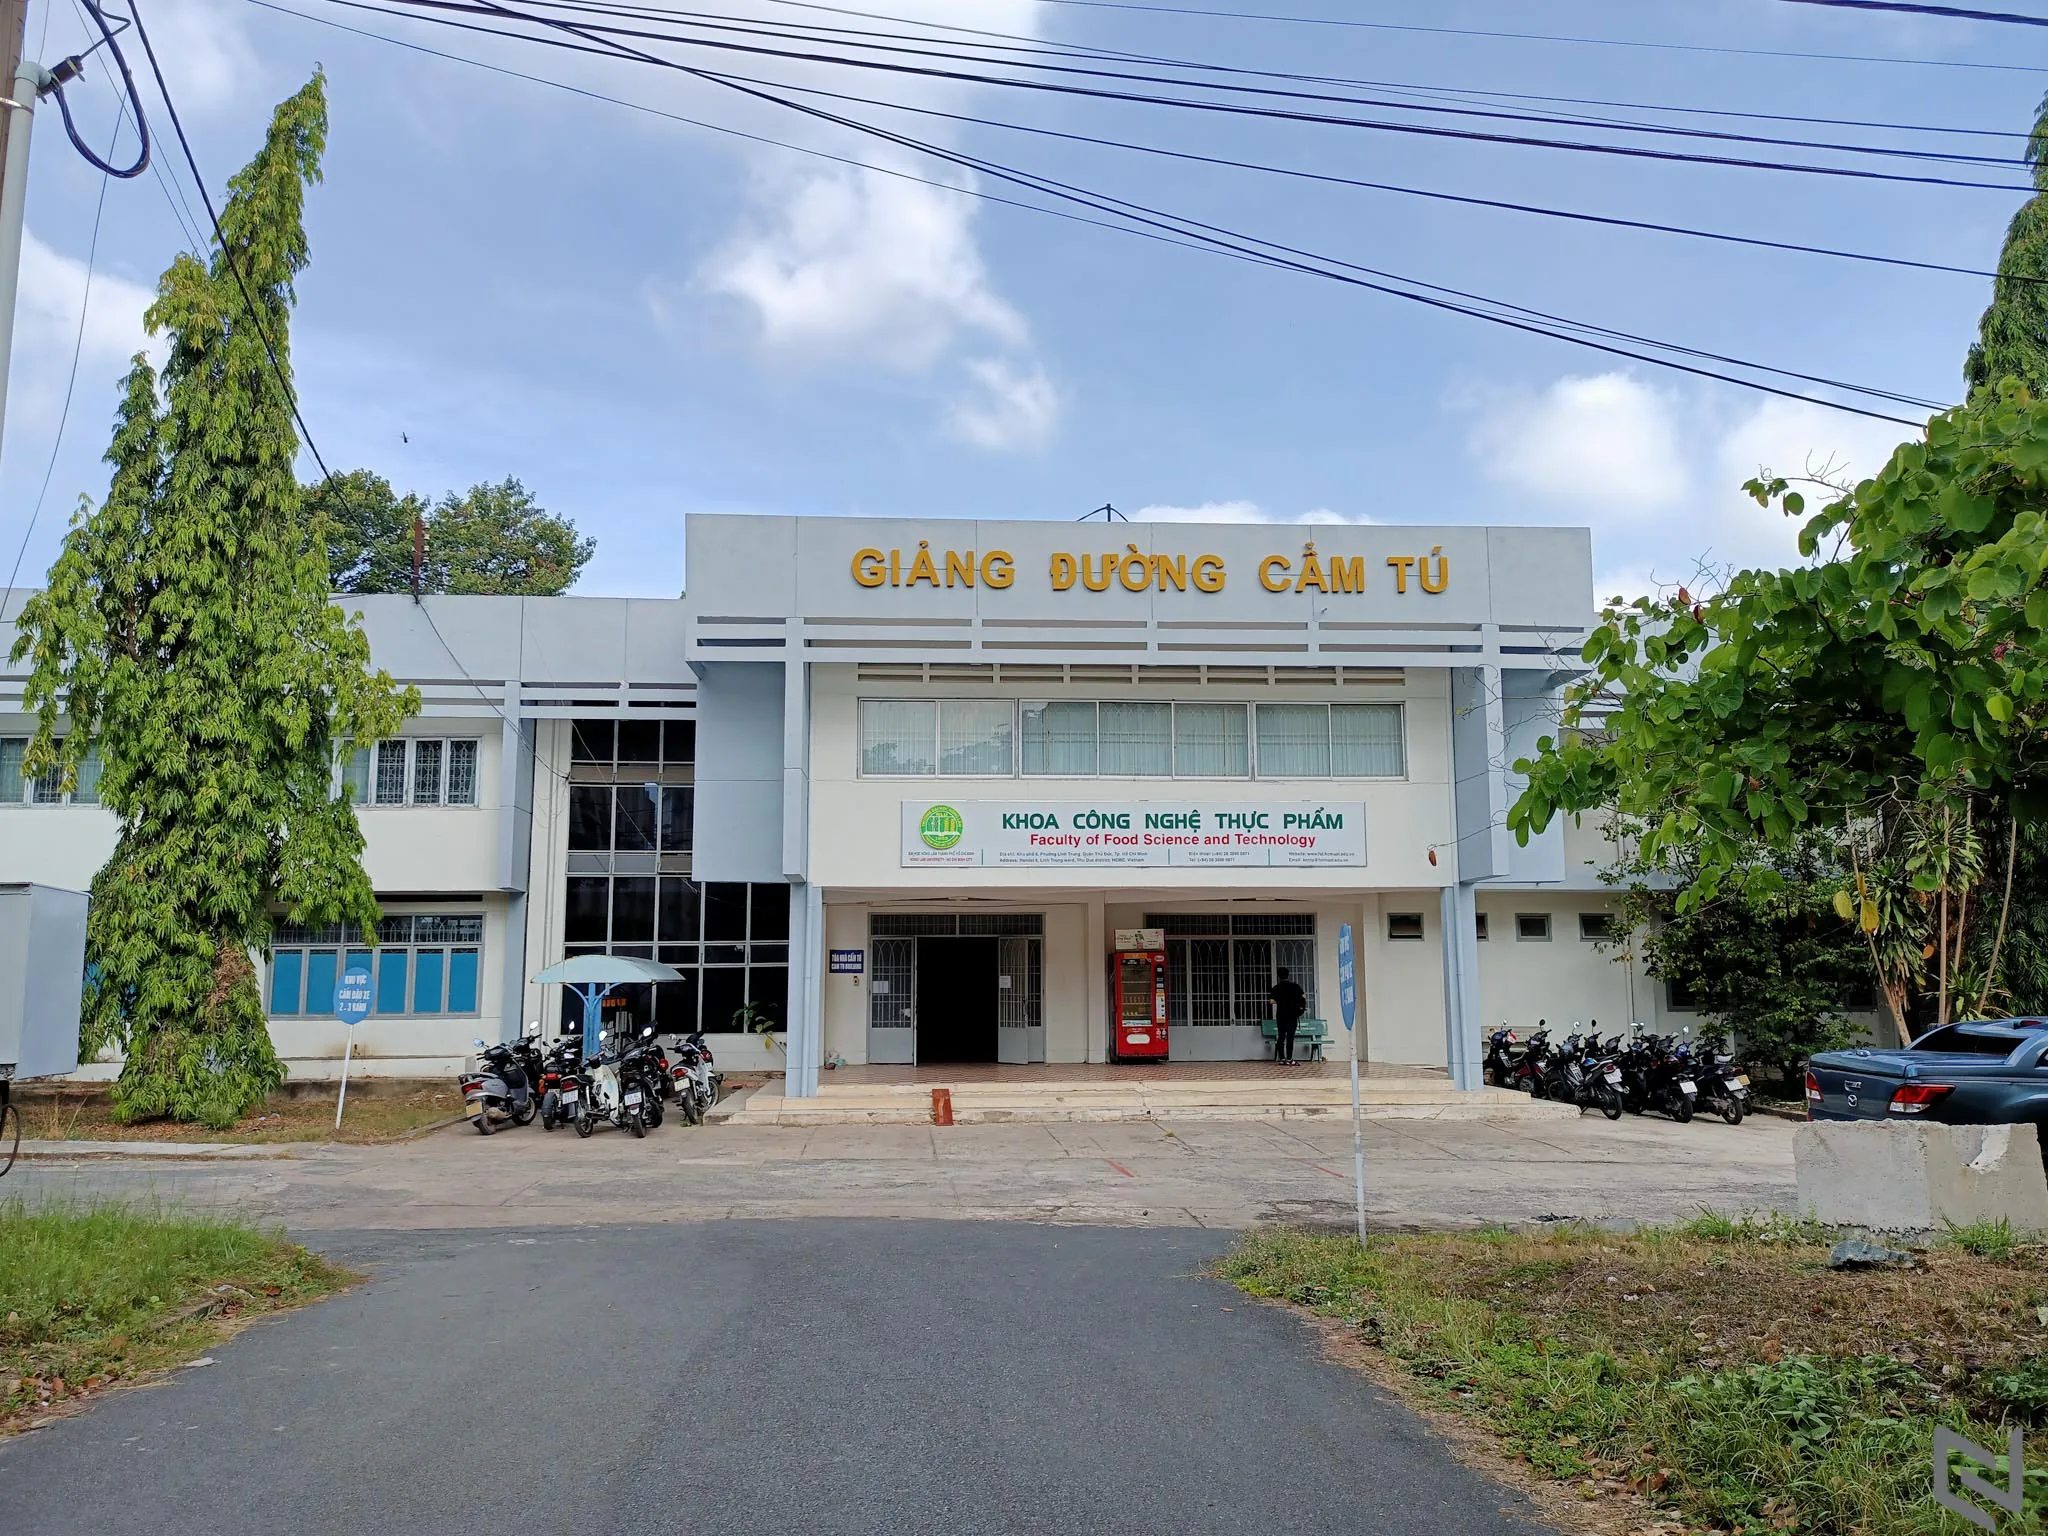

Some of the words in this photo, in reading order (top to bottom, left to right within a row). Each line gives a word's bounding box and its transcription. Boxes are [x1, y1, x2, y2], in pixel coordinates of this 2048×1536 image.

[852, 540, 1015, 589] GIẢNG
[1050, 544, 1226, 593] ĐƯỜNG
[1258, 541, 1365, 593] CẨM
[1386, 545, 1449, 593] TÚ
[1002, 813, 1060, 830] KHOA
[1073, 809, 1130, 830] CÔNG
[1145, 809, 1201, 833] NGHỆ
[1214, 811, 1269, 833] THỰC
[1283, 807, 1343, 830] PHẨM
[1030, 834, 1081, 848] Faculty
[1086, 834, 1100, 846] of
[1104, 834, 1138, 846] Food
[1143, 833, 1200, 846] Science
[1204, 834, 1230, 845] and
[1235, 833, 1316, 848] Technology
